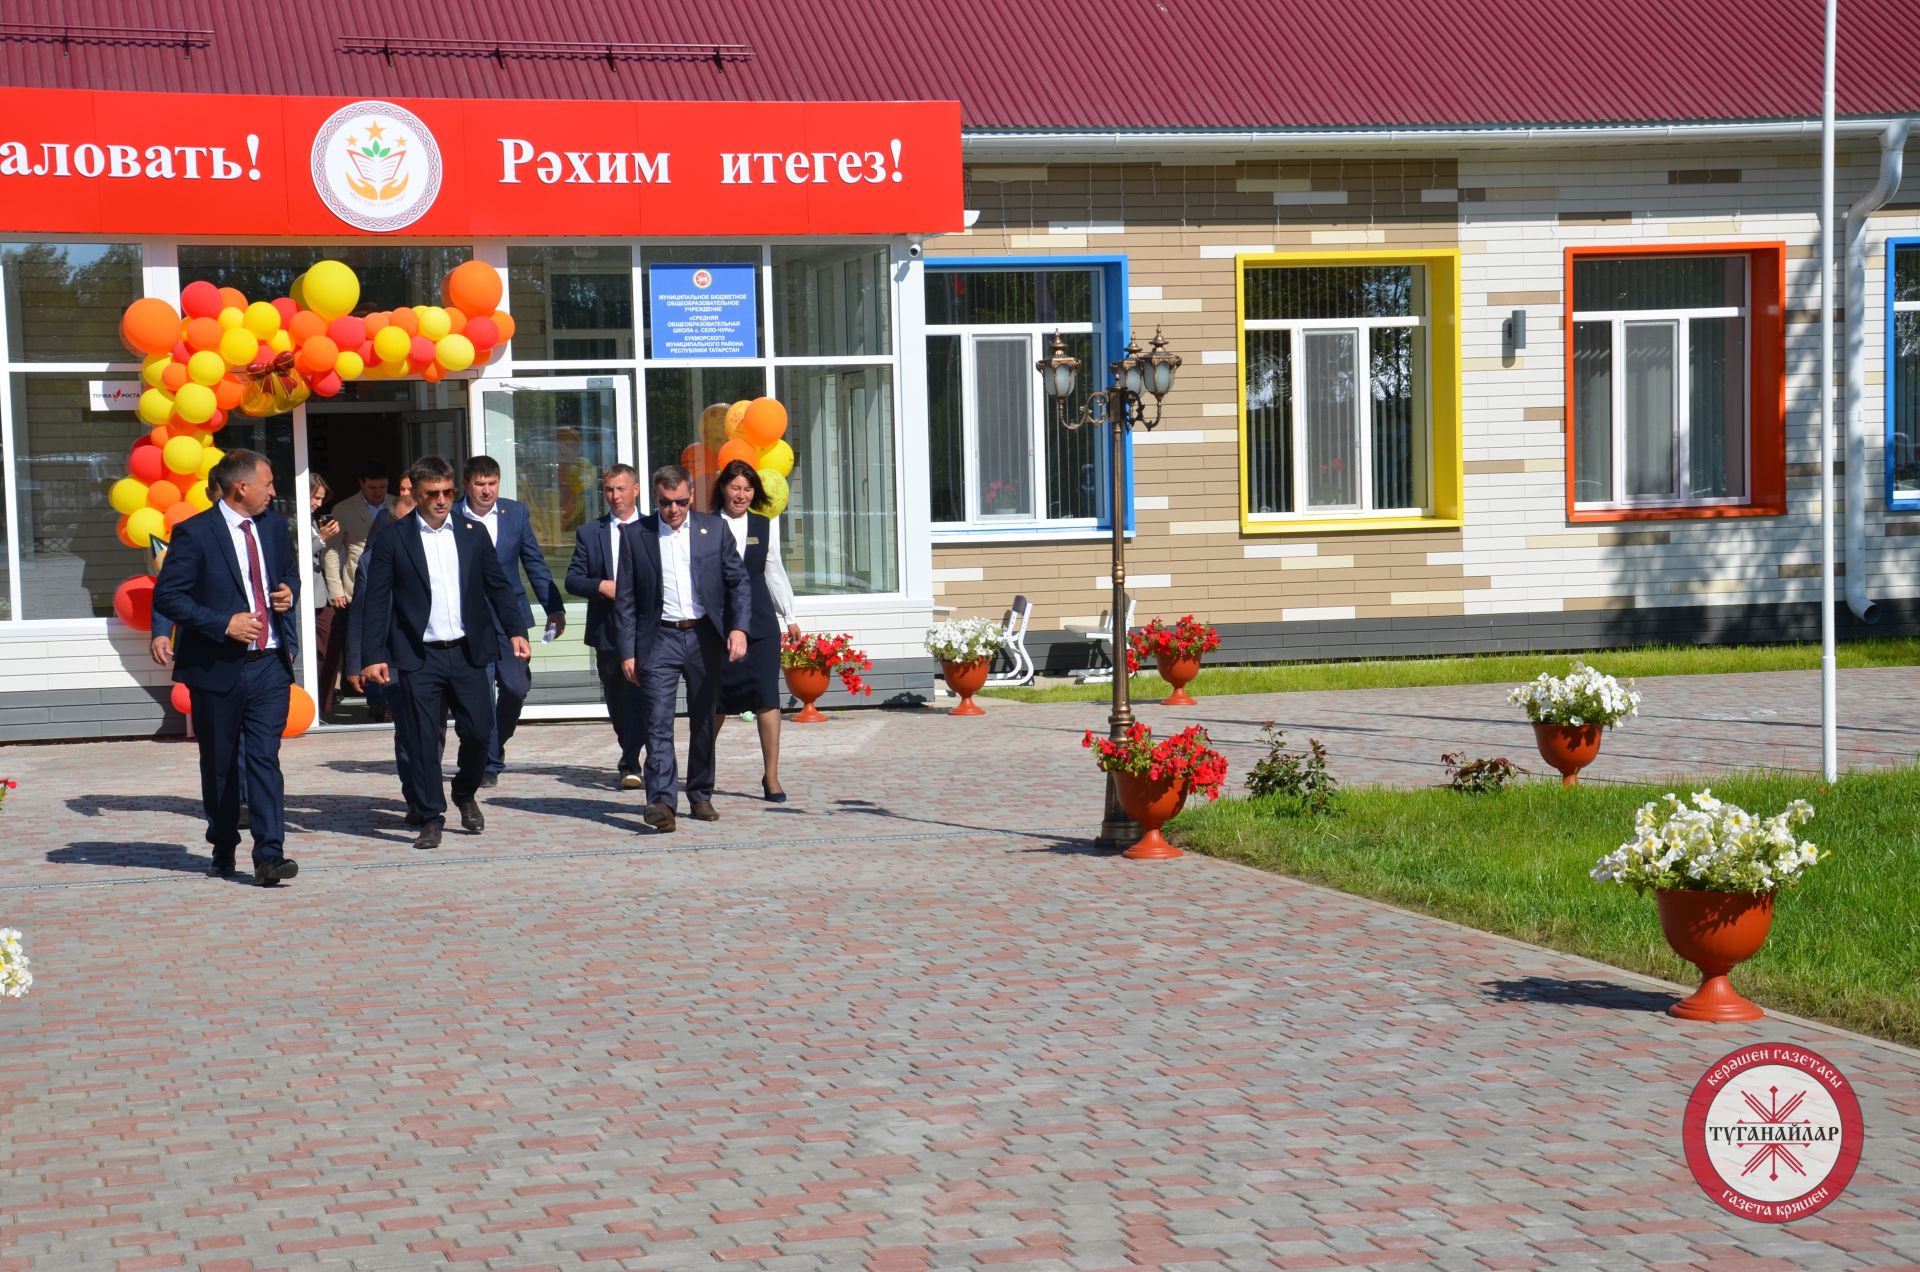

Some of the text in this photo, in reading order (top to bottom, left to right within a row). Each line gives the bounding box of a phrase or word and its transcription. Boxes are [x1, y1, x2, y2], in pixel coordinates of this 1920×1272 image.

[0, 134, 262, 181] аловать!
[496, 138, 904, 185] Рәхим итегез!
